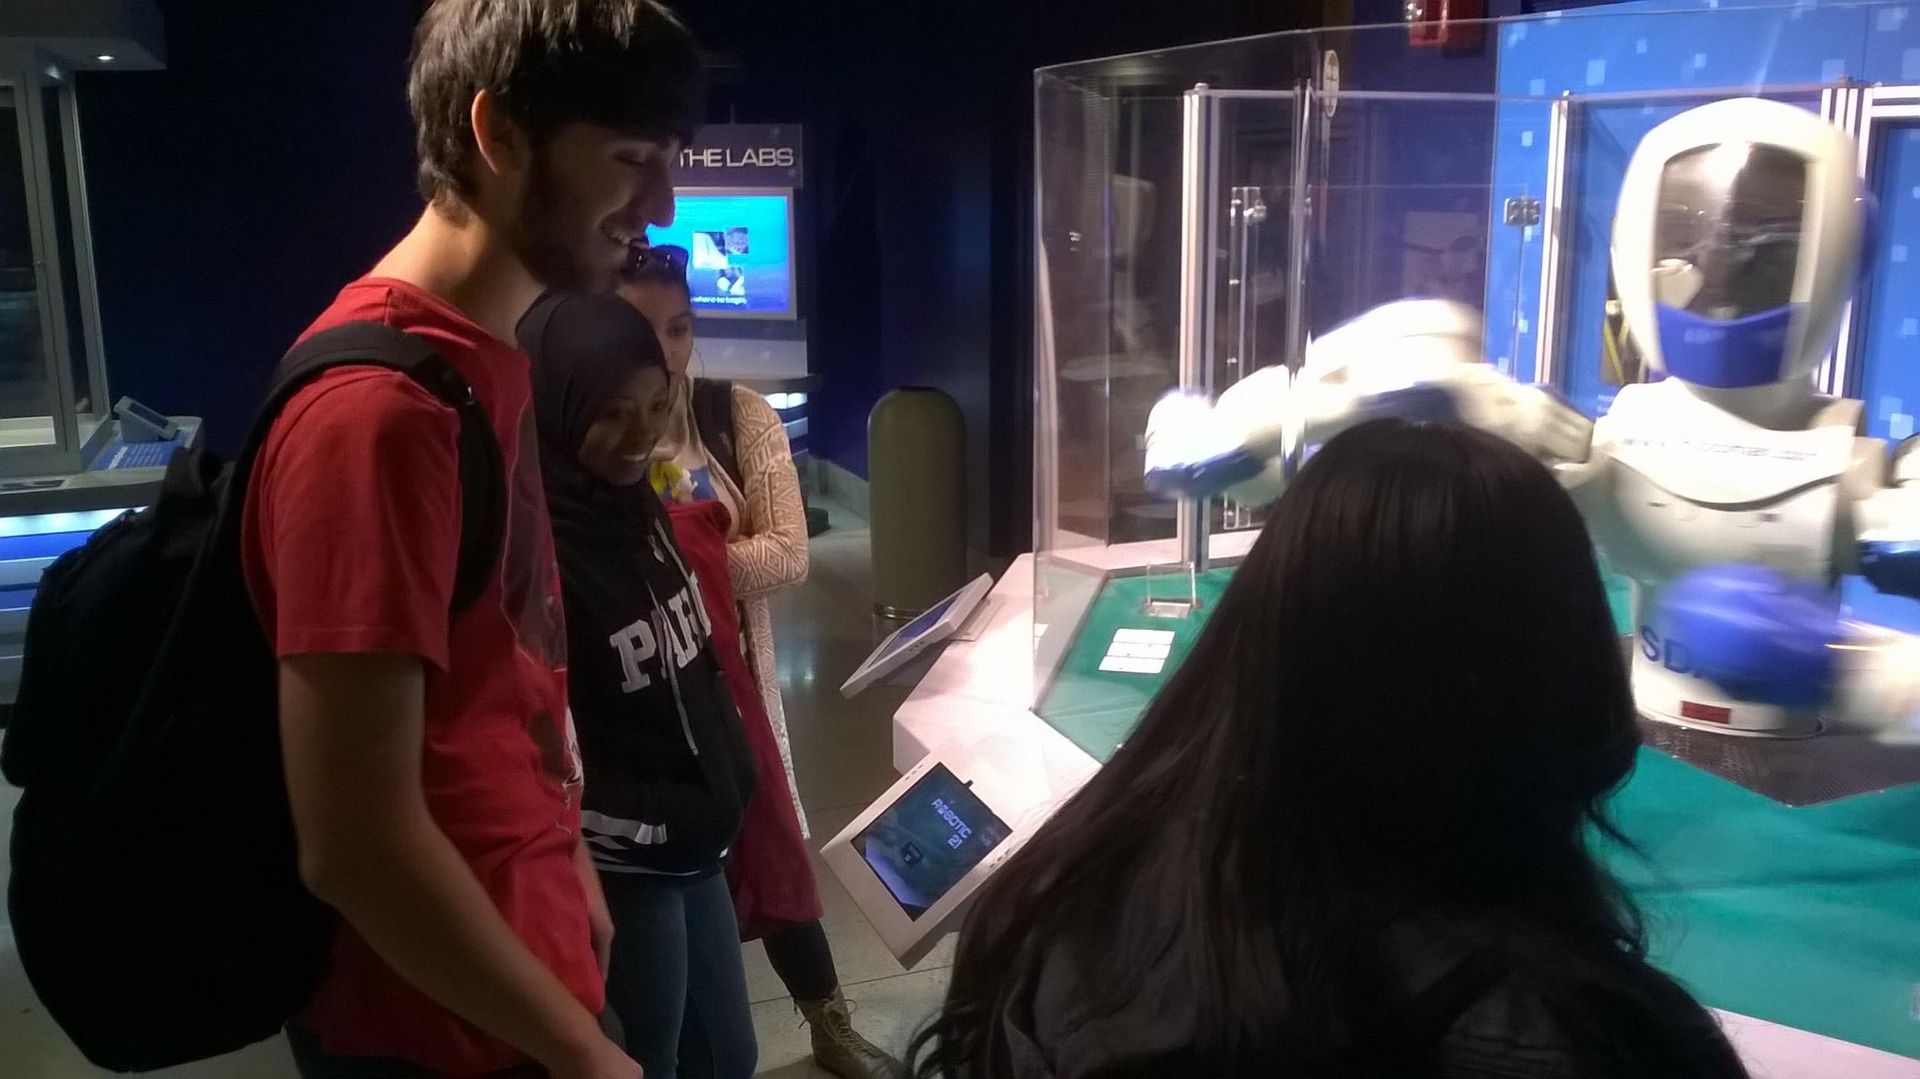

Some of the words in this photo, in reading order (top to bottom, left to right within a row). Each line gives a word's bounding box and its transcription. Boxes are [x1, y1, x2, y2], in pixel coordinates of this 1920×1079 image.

[680, 148, 723, 168] THE
[726, 148, 794, 167] LABS
[1641, 626, 1702, 679] SD
[931, 798, 973, 839] ROBOTIC
